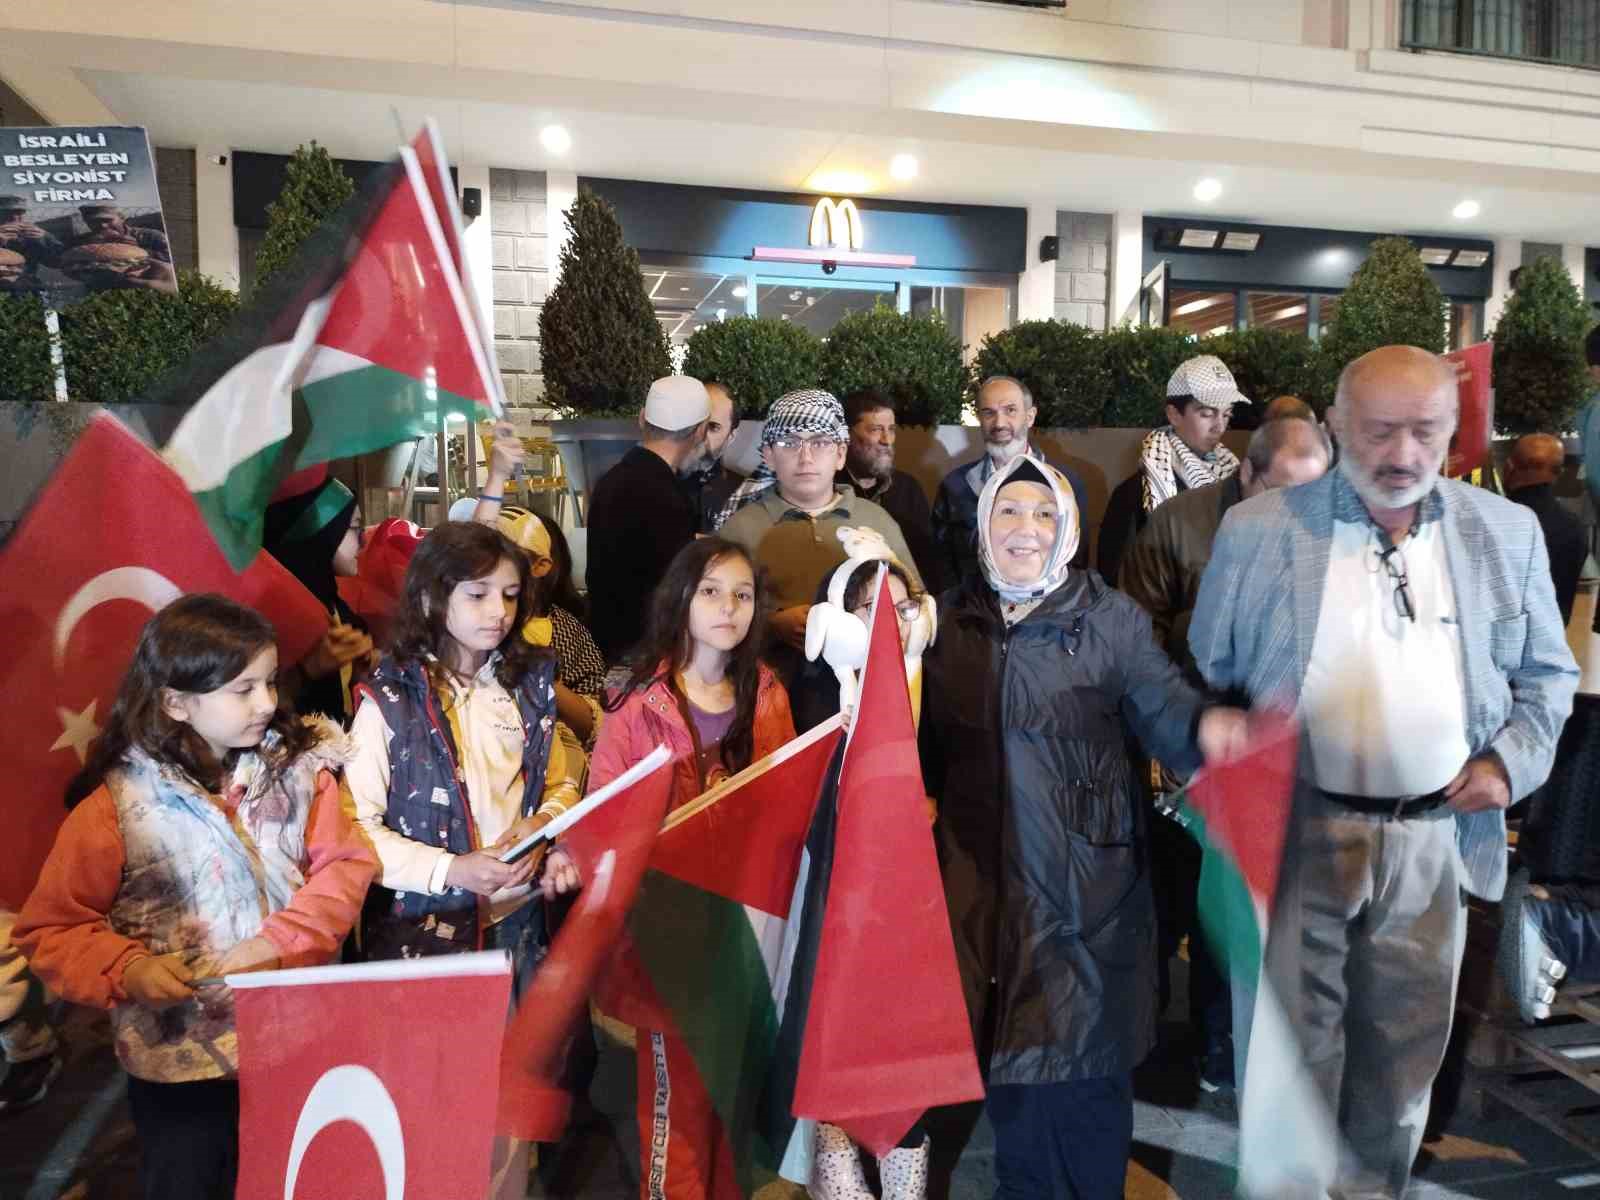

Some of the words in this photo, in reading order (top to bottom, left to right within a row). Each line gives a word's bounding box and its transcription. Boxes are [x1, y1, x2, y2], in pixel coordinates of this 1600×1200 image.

[18, 133, 107, 149] İSRAİLİ
[3, 152, 129, 167] BESLEYEN
[13, 169, 127, 185] SİYONİST
[34, 188, 115, 202] FİRMA
